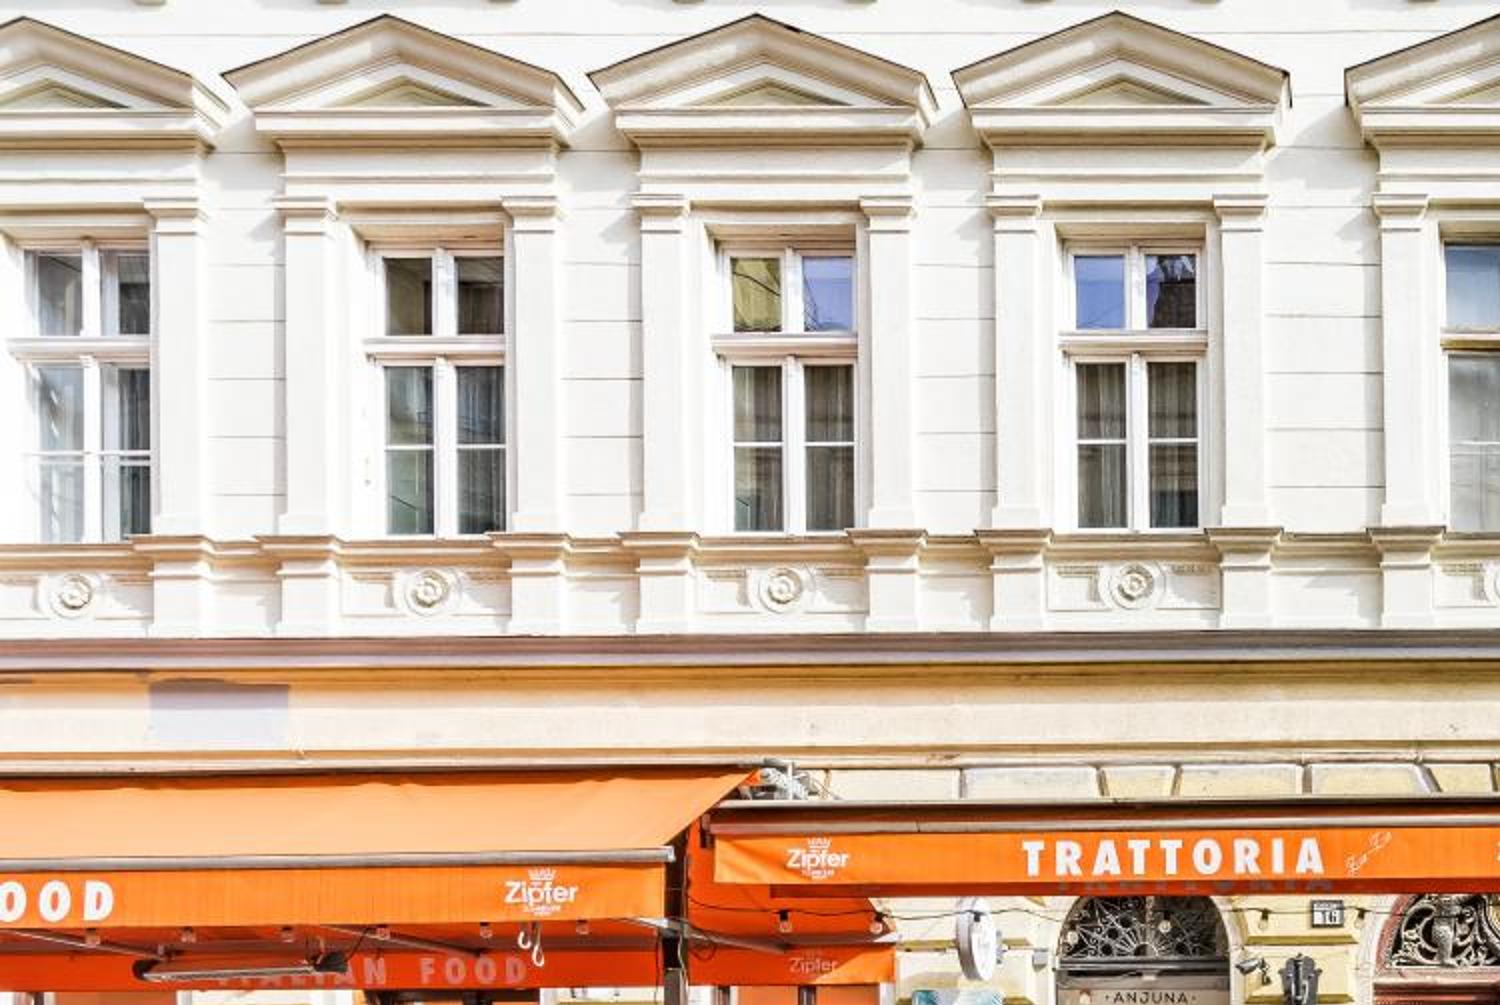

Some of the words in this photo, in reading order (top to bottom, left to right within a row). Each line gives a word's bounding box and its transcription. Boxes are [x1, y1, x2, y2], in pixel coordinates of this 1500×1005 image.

[786, 849, 849, 871] Zipfer
[1022, 838, 1325, 877] TRATTORIA
[504, 880, 579, 907] Zipfer
[1321, 911, 1337, 924] 16
[418, 957, 528, 985] FOOD
[1113, 991, 1188, 1005] ANJUNA
